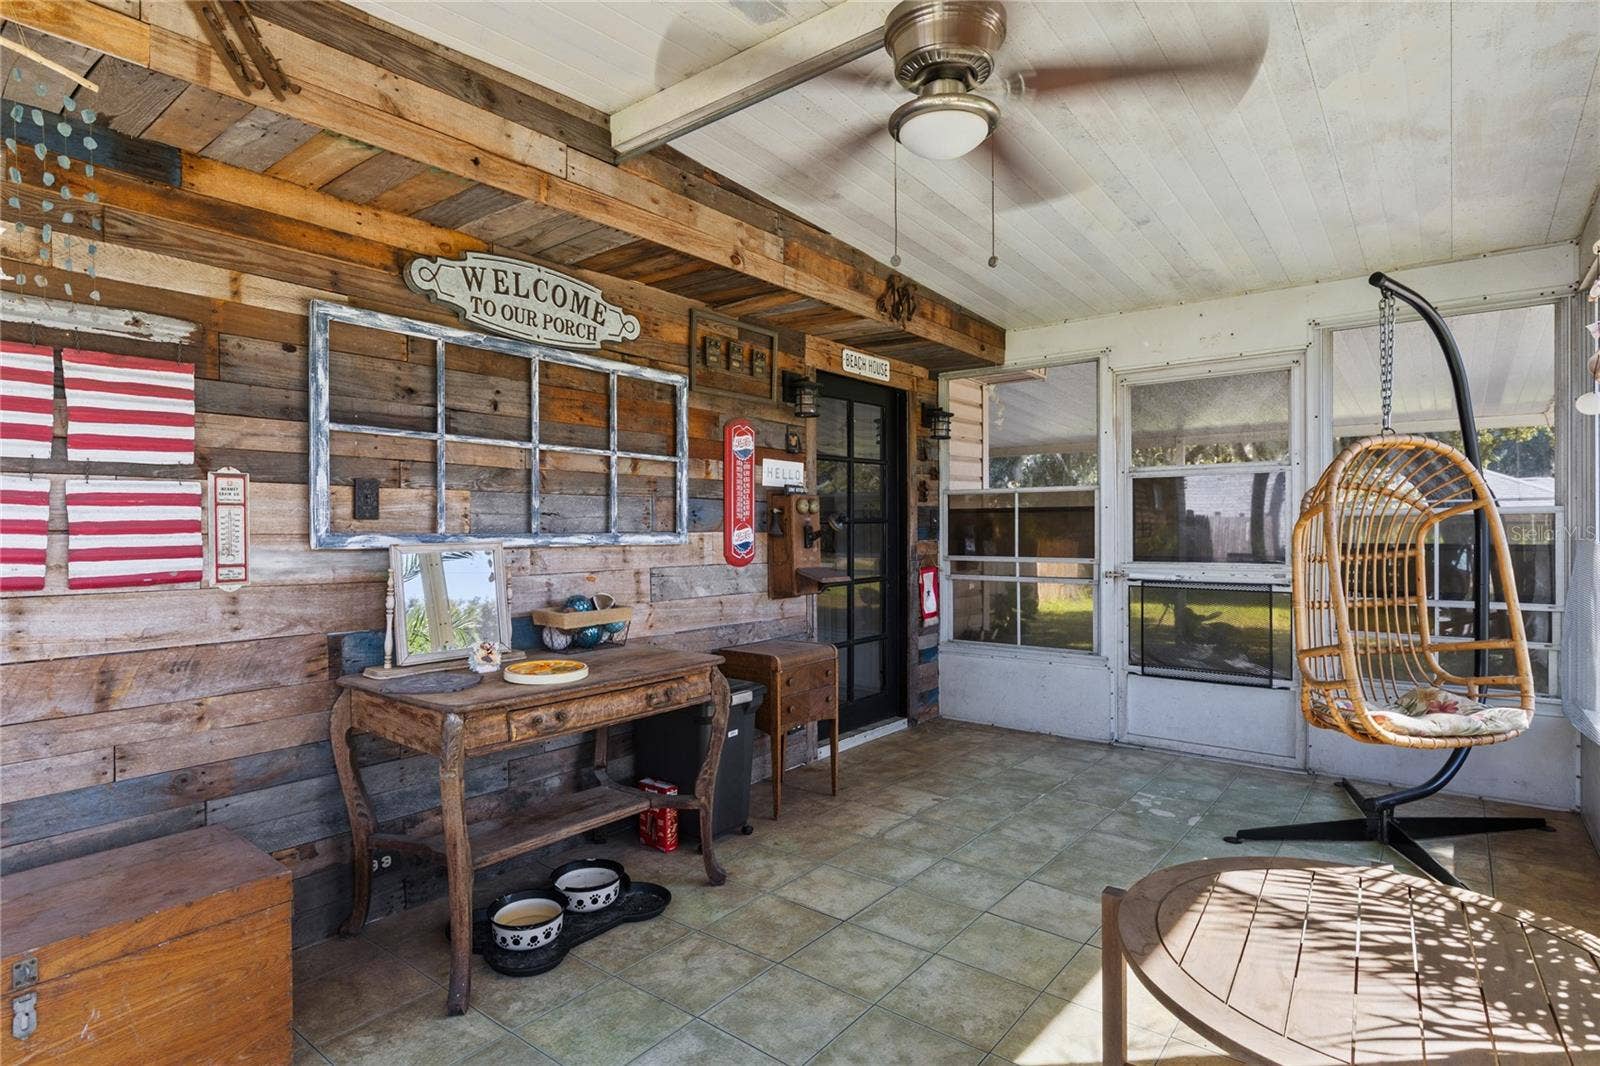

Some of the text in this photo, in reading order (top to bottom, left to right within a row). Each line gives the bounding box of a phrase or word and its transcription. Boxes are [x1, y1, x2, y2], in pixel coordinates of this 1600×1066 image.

[461, 266, 607, 327] WELCOME
[470, 295, 597, 342] TO OUR PORCH
[845, 353, 889, 378] BEACH HOUSE
[767, 467, 800, 481] HELLO
